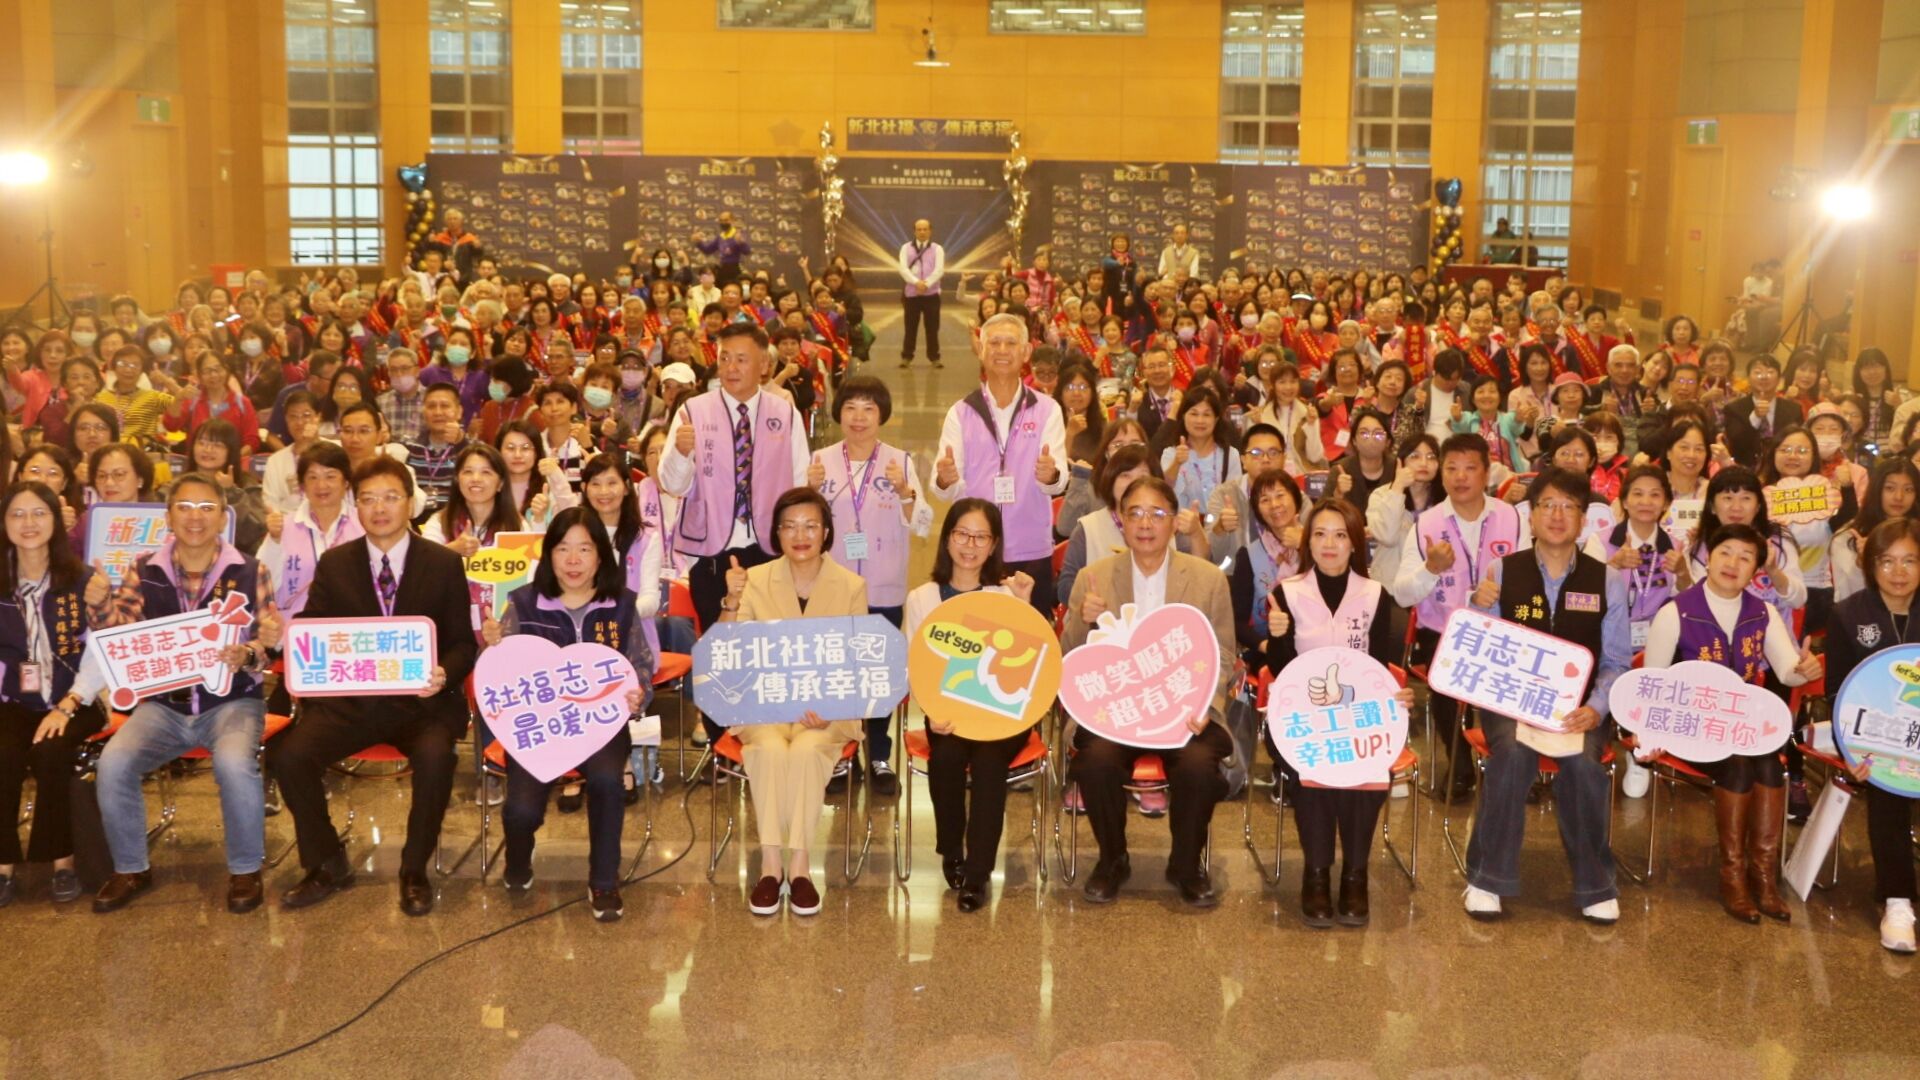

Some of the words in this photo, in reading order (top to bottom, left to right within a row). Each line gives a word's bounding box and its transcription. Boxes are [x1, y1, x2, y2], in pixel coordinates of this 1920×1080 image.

[848, 119, 914, 135] 新北社福
[104, 517, 176, 545] 新北
[466, 557, 502, 573] let's
[504, 560, 527, 575] go
[105, 625, 201, 661] 社福志工
[327, 629, 425, 655] 志在新北
[710, 632, 846, 671] 新北社福
[1451, 620, 1558, 681] 有志工
[125, 647, 220, 684] 感謝有您
[328, 657, 425, 683] 永續發展
[1074, 623, 1194, 703] 微笑服務
[482, 657, 626, 714] 社福志工
[751, 666, 892, 705] 傳承幸福
[1105, 664, 1199, 730] 超有愛
[1448, 656, 1560, 720] 好幸福
[1635, 674, 1749, 716] 新北志工
[512, 701, 621, 750] 最暖心
[1644, 706, 1758, 748] 感謝有你
